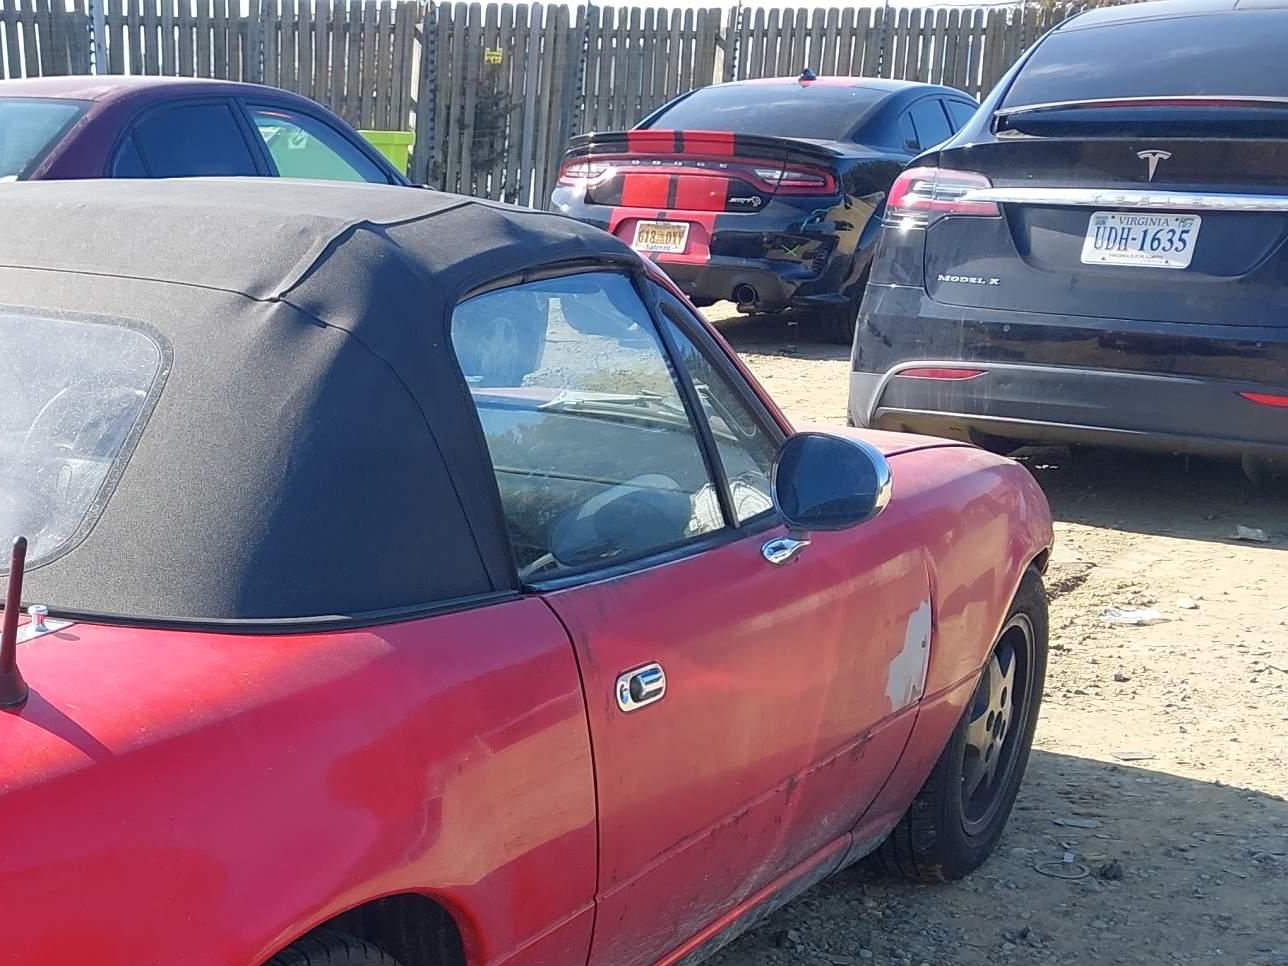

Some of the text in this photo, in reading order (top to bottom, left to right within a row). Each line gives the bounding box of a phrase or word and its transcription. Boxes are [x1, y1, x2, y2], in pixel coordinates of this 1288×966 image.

[1119, 216, 1170, 227] VIRGINIA
[1093, 226, 1191, 252] UDH-1635
[937, 274, 986, 284] MODEL
